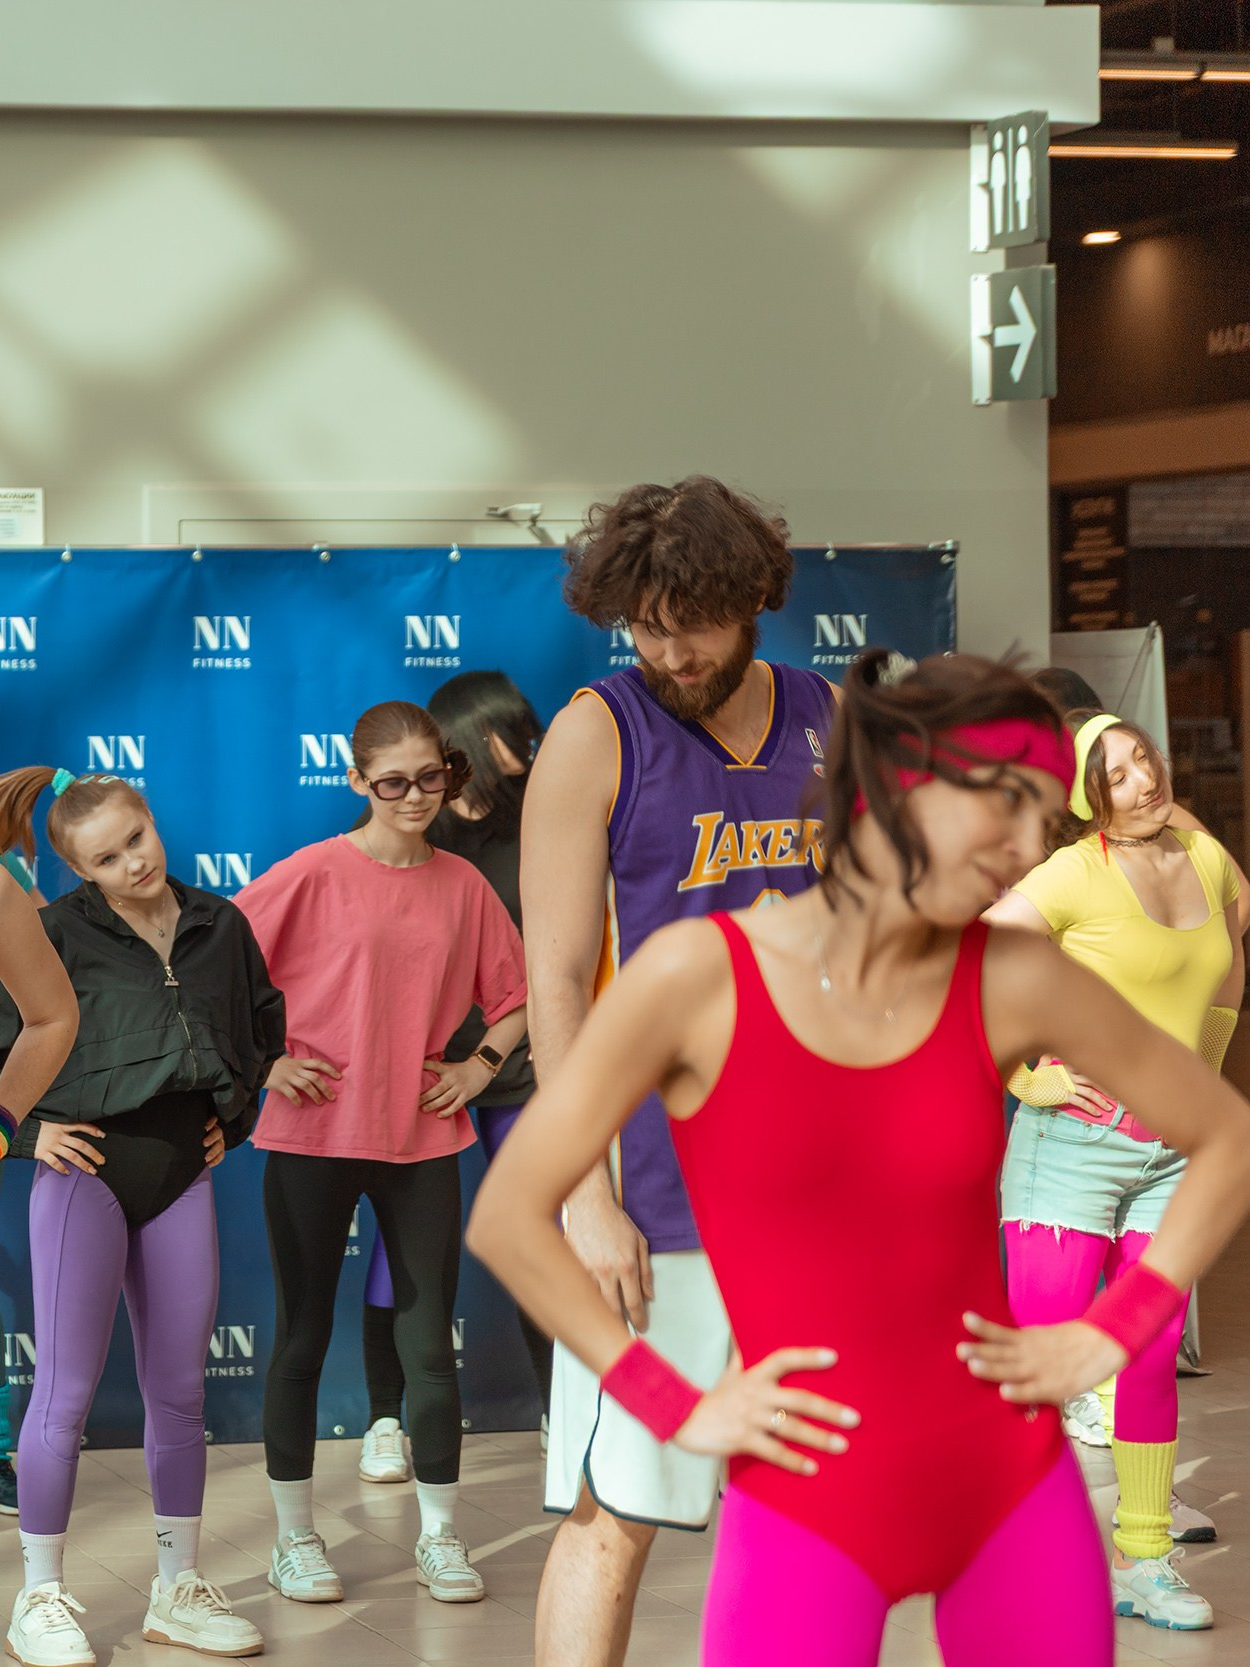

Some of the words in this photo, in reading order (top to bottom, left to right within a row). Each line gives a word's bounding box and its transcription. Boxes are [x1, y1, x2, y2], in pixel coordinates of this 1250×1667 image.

[193, 615, 251, 650] NN
[404, 615, 461, 650] NN
[610, 617, 635, 648] N
[813, 614, 868, 647] NN
[192, 657, 252, 669] FITNESS
[404, 656, 462, 668] FITNESS
[610, 655, 641, 665] FITN
[87, 735, 146, 770] NN
[300, 734, 356, 768] NN
[299, 775, 349, 786] FITNES
[677, 811, 827, 893] LAKER
[195, 853, 253, 887] NN
[4, 1333, 36, 1367] N
[205, 1366, 255, 1377] ITNESS
